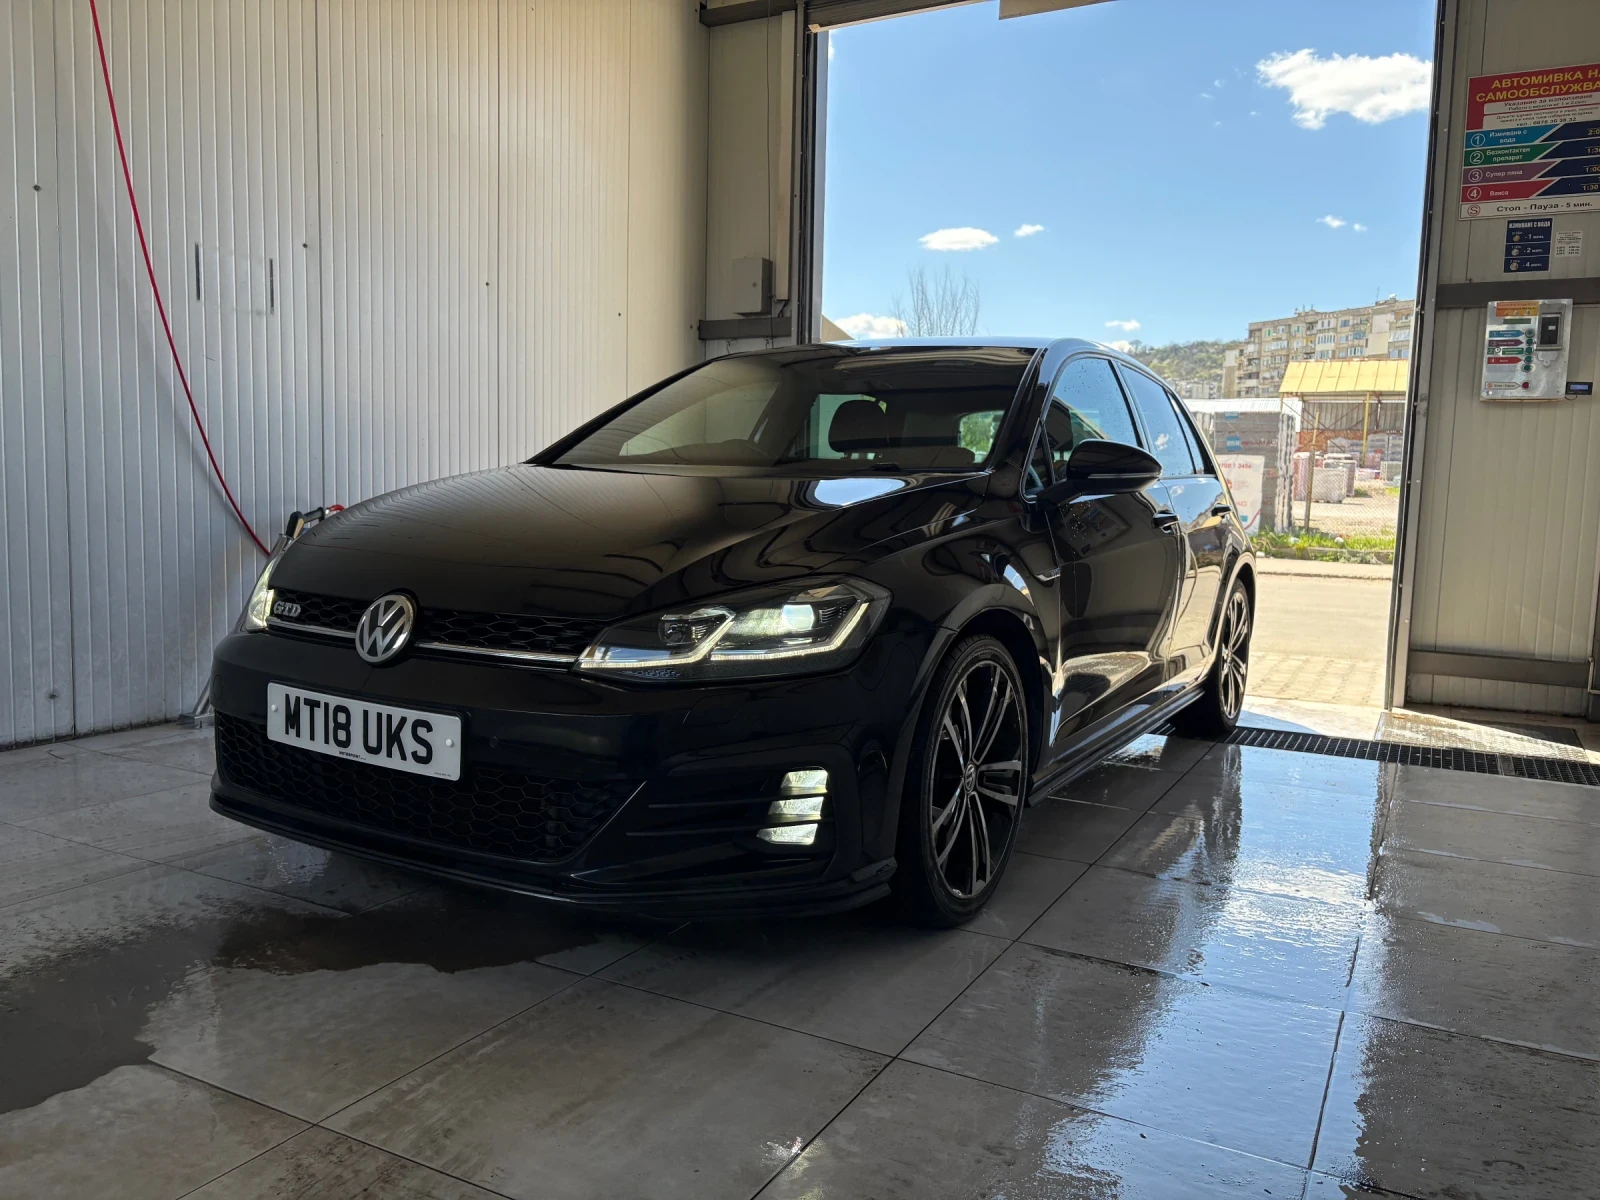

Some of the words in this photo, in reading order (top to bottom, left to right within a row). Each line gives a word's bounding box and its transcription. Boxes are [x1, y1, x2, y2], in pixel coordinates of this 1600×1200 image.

[1491, 71, 1583, 89] АВТОМИВКА
[1588, 69, 1600, 79] Н
[1476, 81, 1600, 102] САМООБСЛУЖВА
[1473, 152, 1481, 163] 2
[1472, 171, 1479, 181] 3
[1470, 188, 1478, 199] 4
[1530, 203, 1559, 211] Пауза
[273, 600, 302, 618] GTD
[284, 693, 352, 749] MT18
[362, 709, 434, 765] UKS
